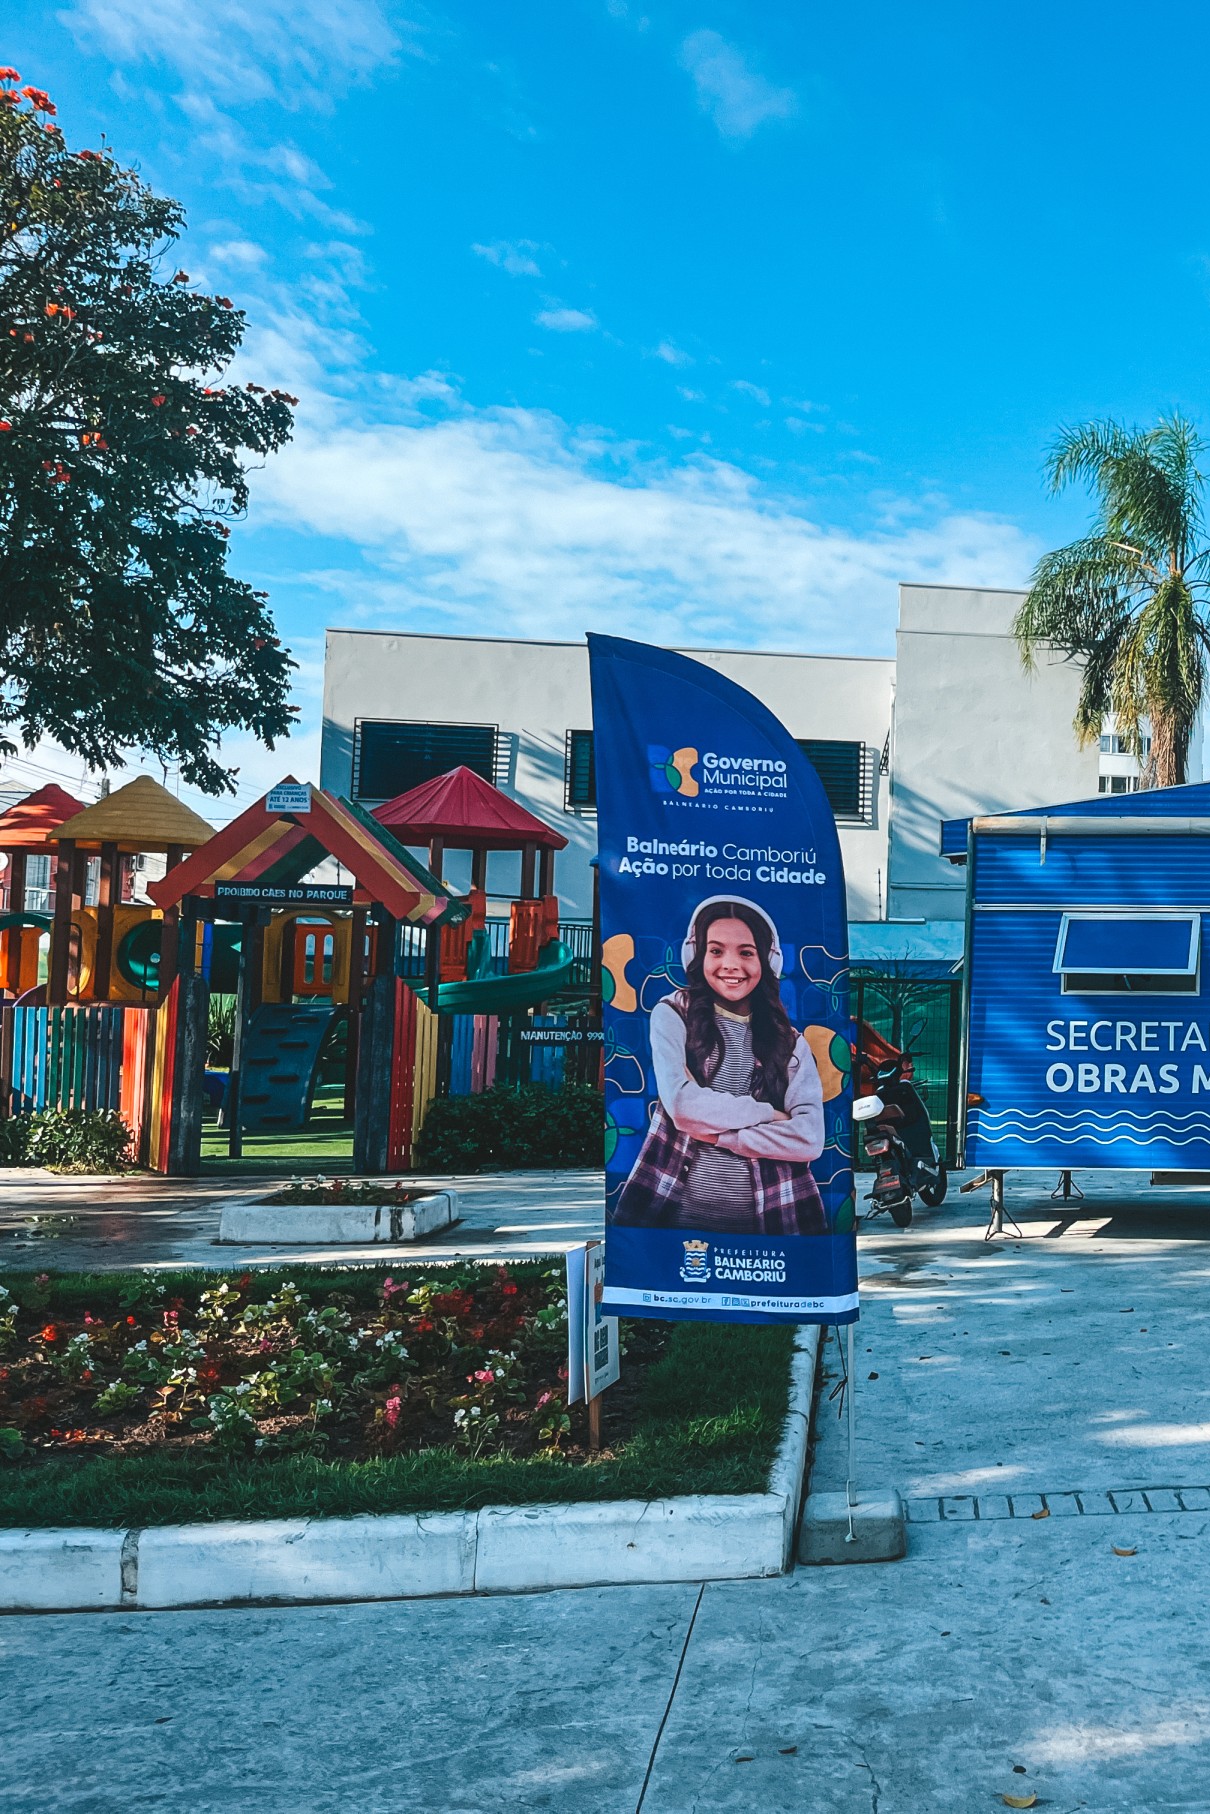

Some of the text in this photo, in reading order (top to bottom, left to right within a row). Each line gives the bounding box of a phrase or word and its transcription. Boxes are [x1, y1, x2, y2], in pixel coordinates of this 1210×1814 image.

[703, 752, 787, 773] Governo
[703, 768, 788, 790] Municipal
[626, 836, 817, 865] Balneário Camboriú
[618, 856, 827, 885] Ação por toda Cidade
[217, 886, 260, 897] PROIBIDO
[288, 889, 304, 899] NO
[306, 889, 348, 900] PARQUE
[520, 1030, 583, 1041] MANUTENÇÃO
[1045, 1062, 1180, 1093] OBRAS
[713, 1247, 786, 1257] PREFEITURA
[714, 1255, 786, 1270] BALNEÁRIO
[714, 1267, 787, 1282] CAMBORIÚ
[750, 1300, 825, 1308] prefeituradebc
